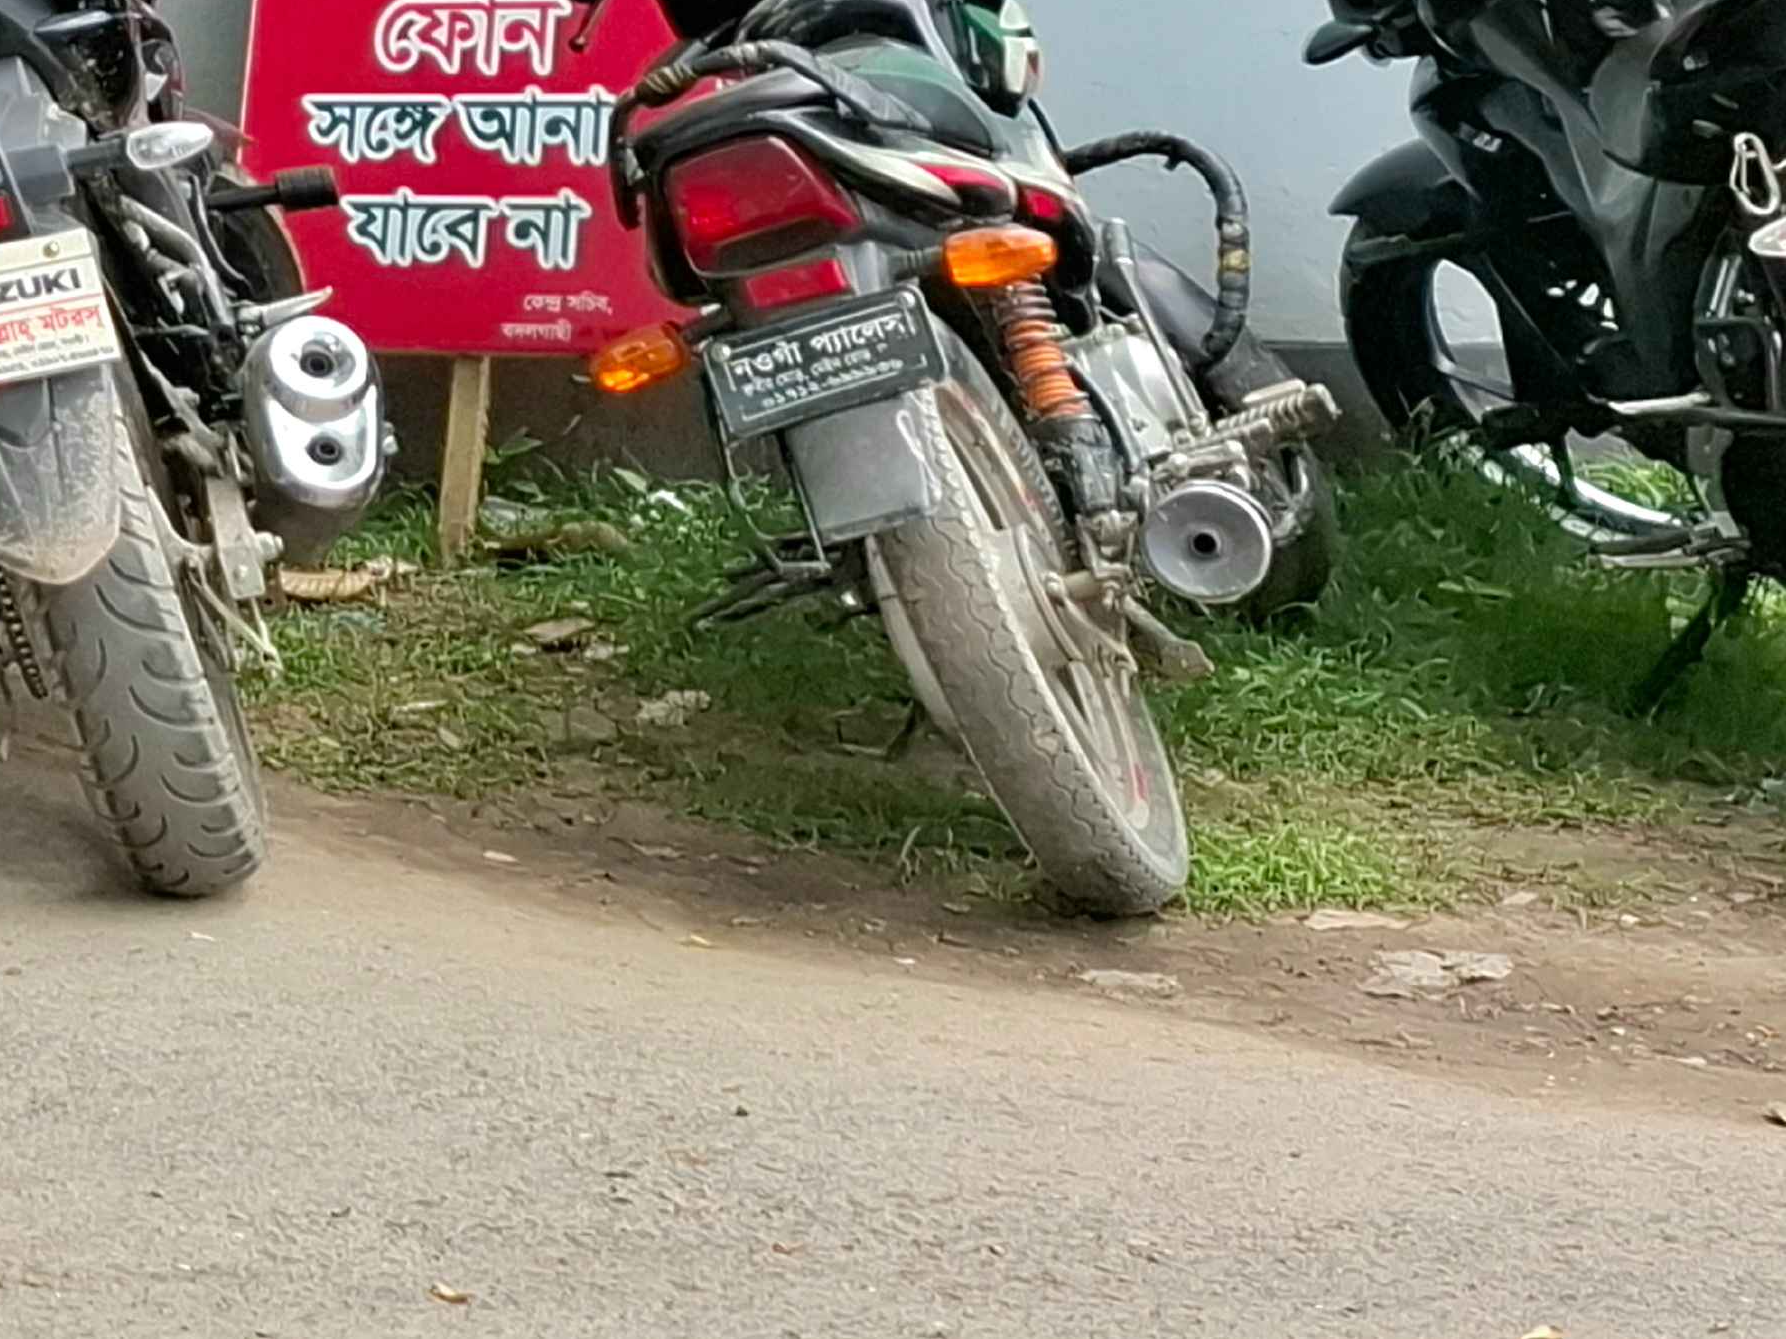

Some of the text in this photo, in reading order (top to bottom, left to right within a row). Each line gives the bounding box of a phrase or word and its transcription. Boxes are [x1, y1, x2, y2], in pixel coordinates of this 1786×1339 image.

[300, 83, 619, 168] সঙ্গে আনা
[341, 187, 593, 271] যাবে না
